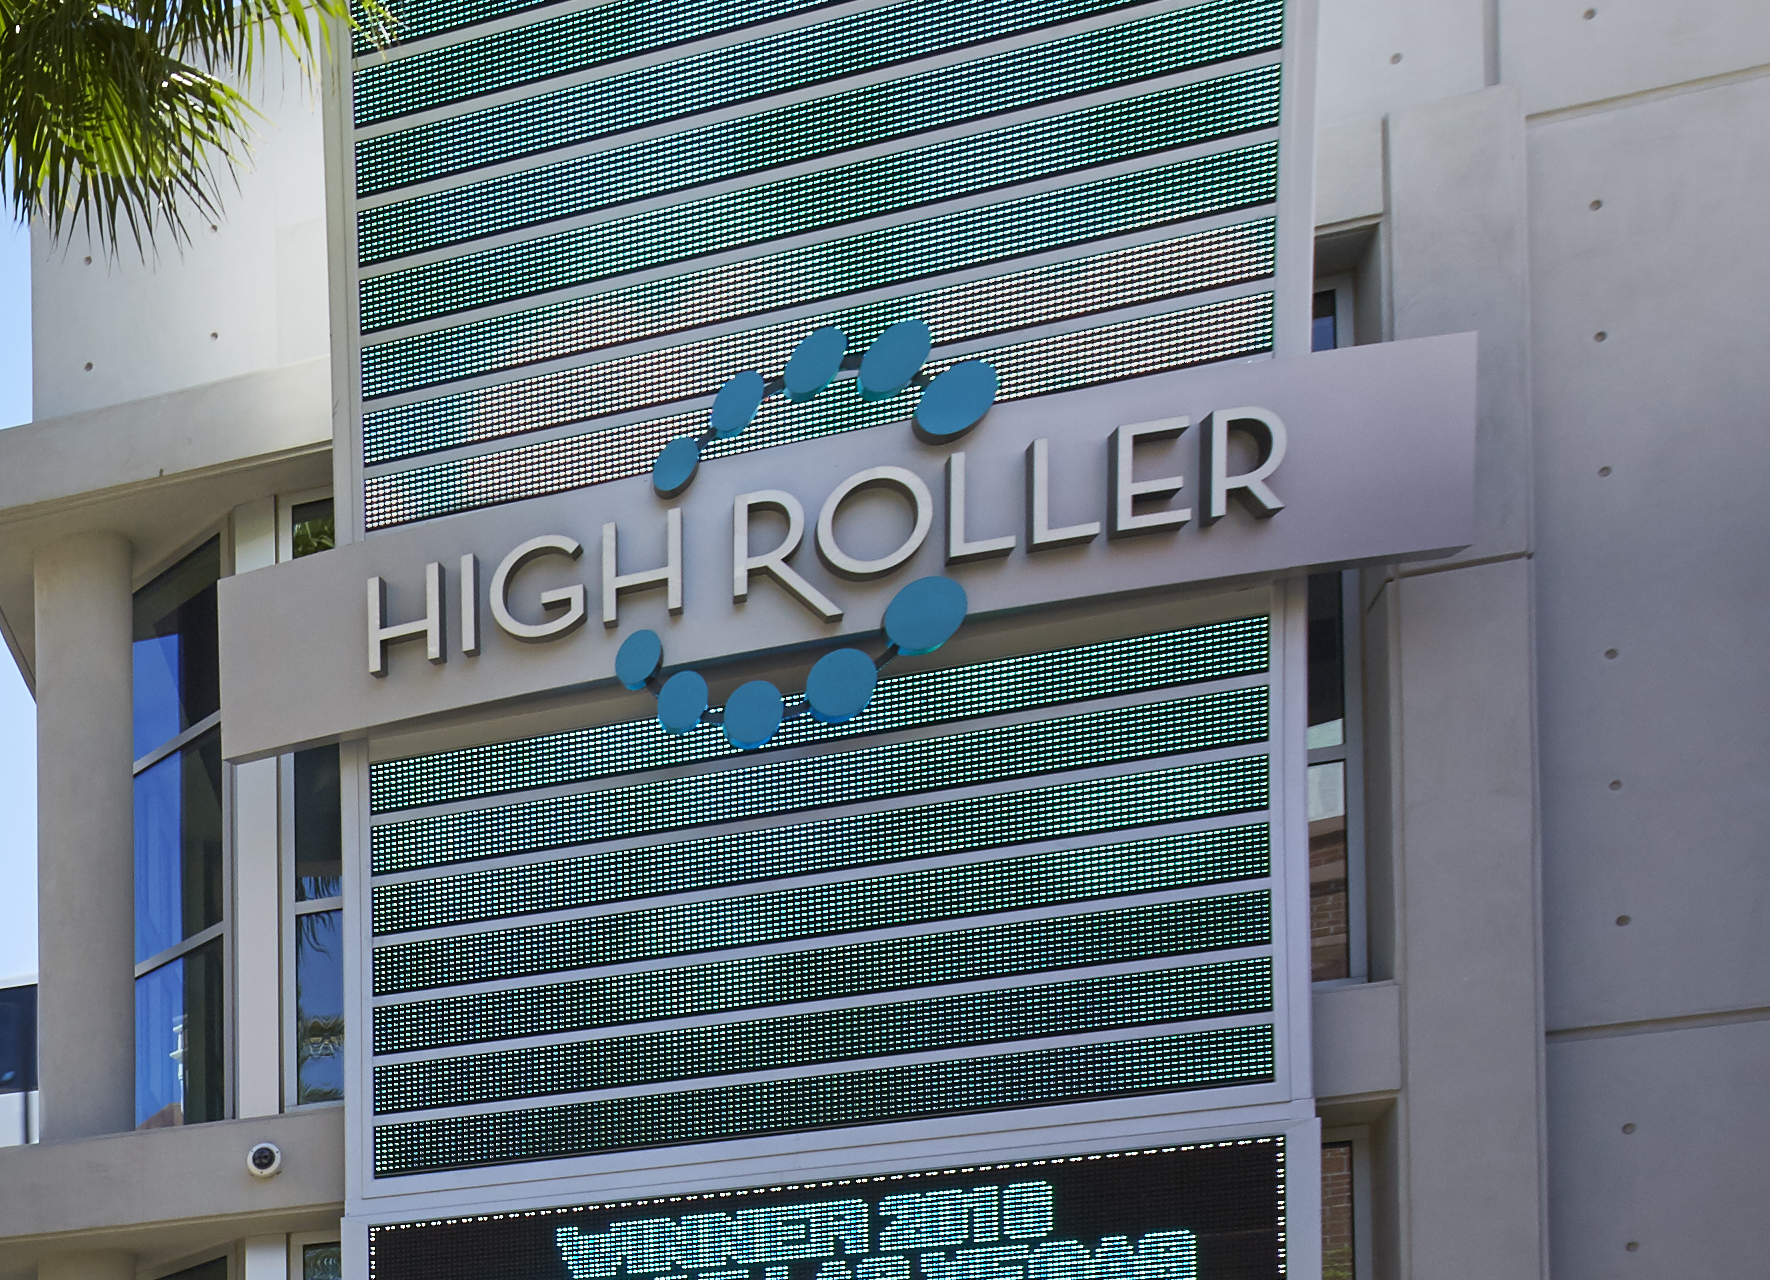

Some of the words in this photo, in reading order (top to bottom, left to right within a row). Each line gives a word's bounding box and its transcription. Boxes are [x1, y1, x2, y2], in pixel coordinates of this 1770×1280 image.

[367, 508, 688, 678] HIGH
[732, 404, 1289, 624] ROLLER
[556, 1198, 870, 1280] WINNER
[878, 1180, 1054, 1252] 2016
